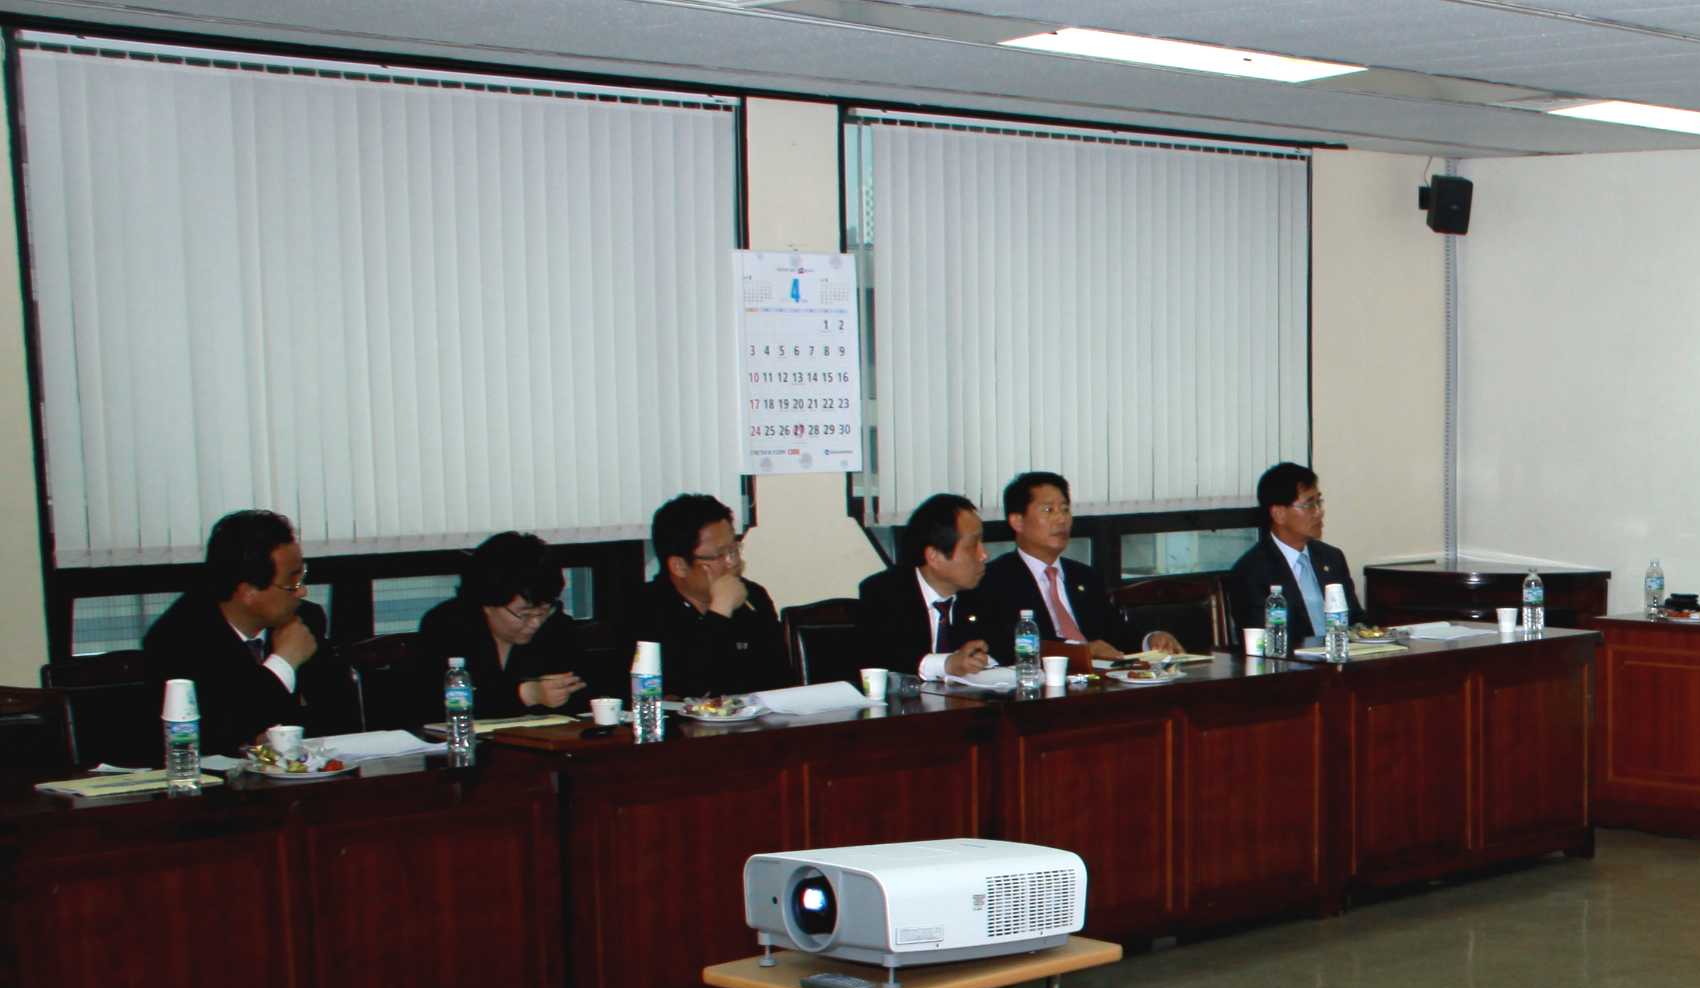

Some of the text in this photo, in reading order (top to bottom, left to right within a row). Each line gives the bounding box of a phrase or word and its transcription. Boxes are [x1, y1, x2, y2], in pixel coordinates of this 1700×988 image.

[790, 278, 800, 303] 4
[824, 320, 844, 330] 1 2
[750, 346, 845, 356] 3 4 5 6 7 8 9
[749, 373, 848, 383] 10 11 12 13 14 15 16
[750, 399, 849, 409] 17 18 19 20 21 22 23
[751, 426, 761, 436] 24
[765, 426, 775, 436] 25
[779, 426, 790, 436] 26
[809, 425, 819, 435] 28
[824, 425, 835, 435] 29
[839, 424, 850, 435] 30
